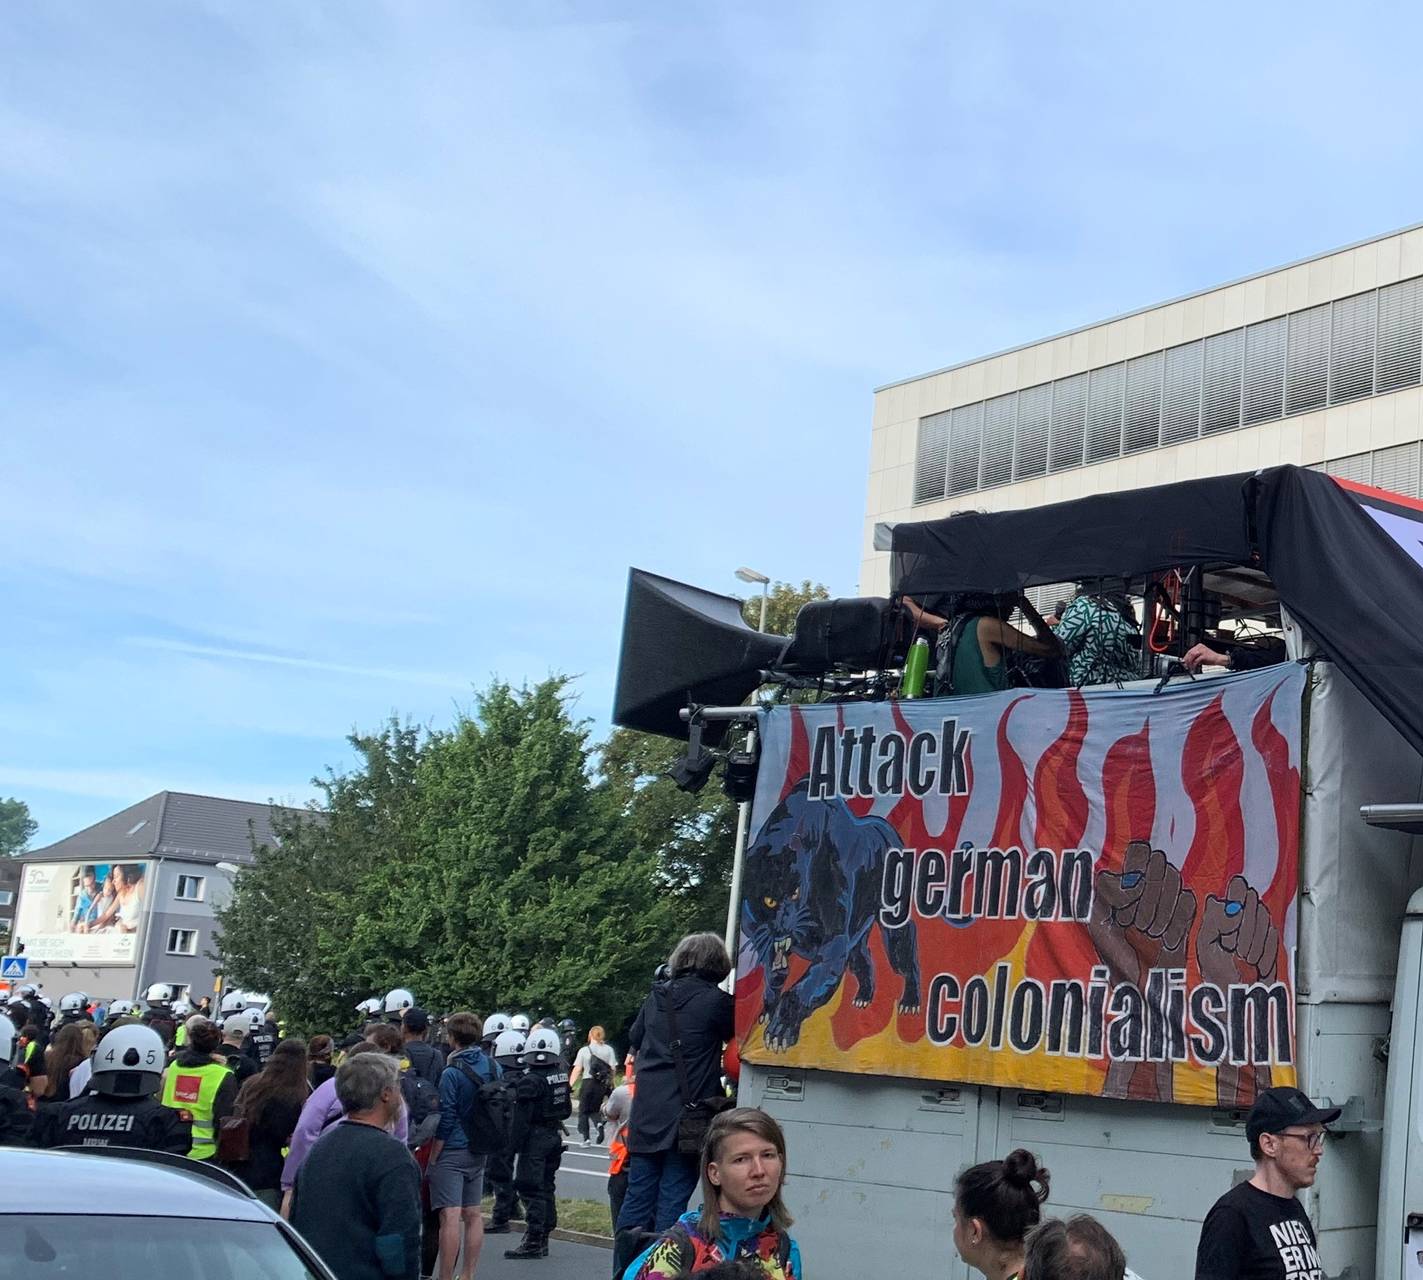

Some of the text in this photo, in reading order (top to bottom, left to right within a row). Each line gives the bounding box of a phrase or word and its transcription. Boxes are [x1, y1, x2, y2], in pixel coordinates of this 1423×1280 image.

[808, 717, 972, 801] Attack
[880, 846, 1095, 929] german
[925, 963, 1292, 1066] colonialism
[105, 1049, 155, 1065] 4 5
[67, 1114, 134, 1131] POLIZEI
